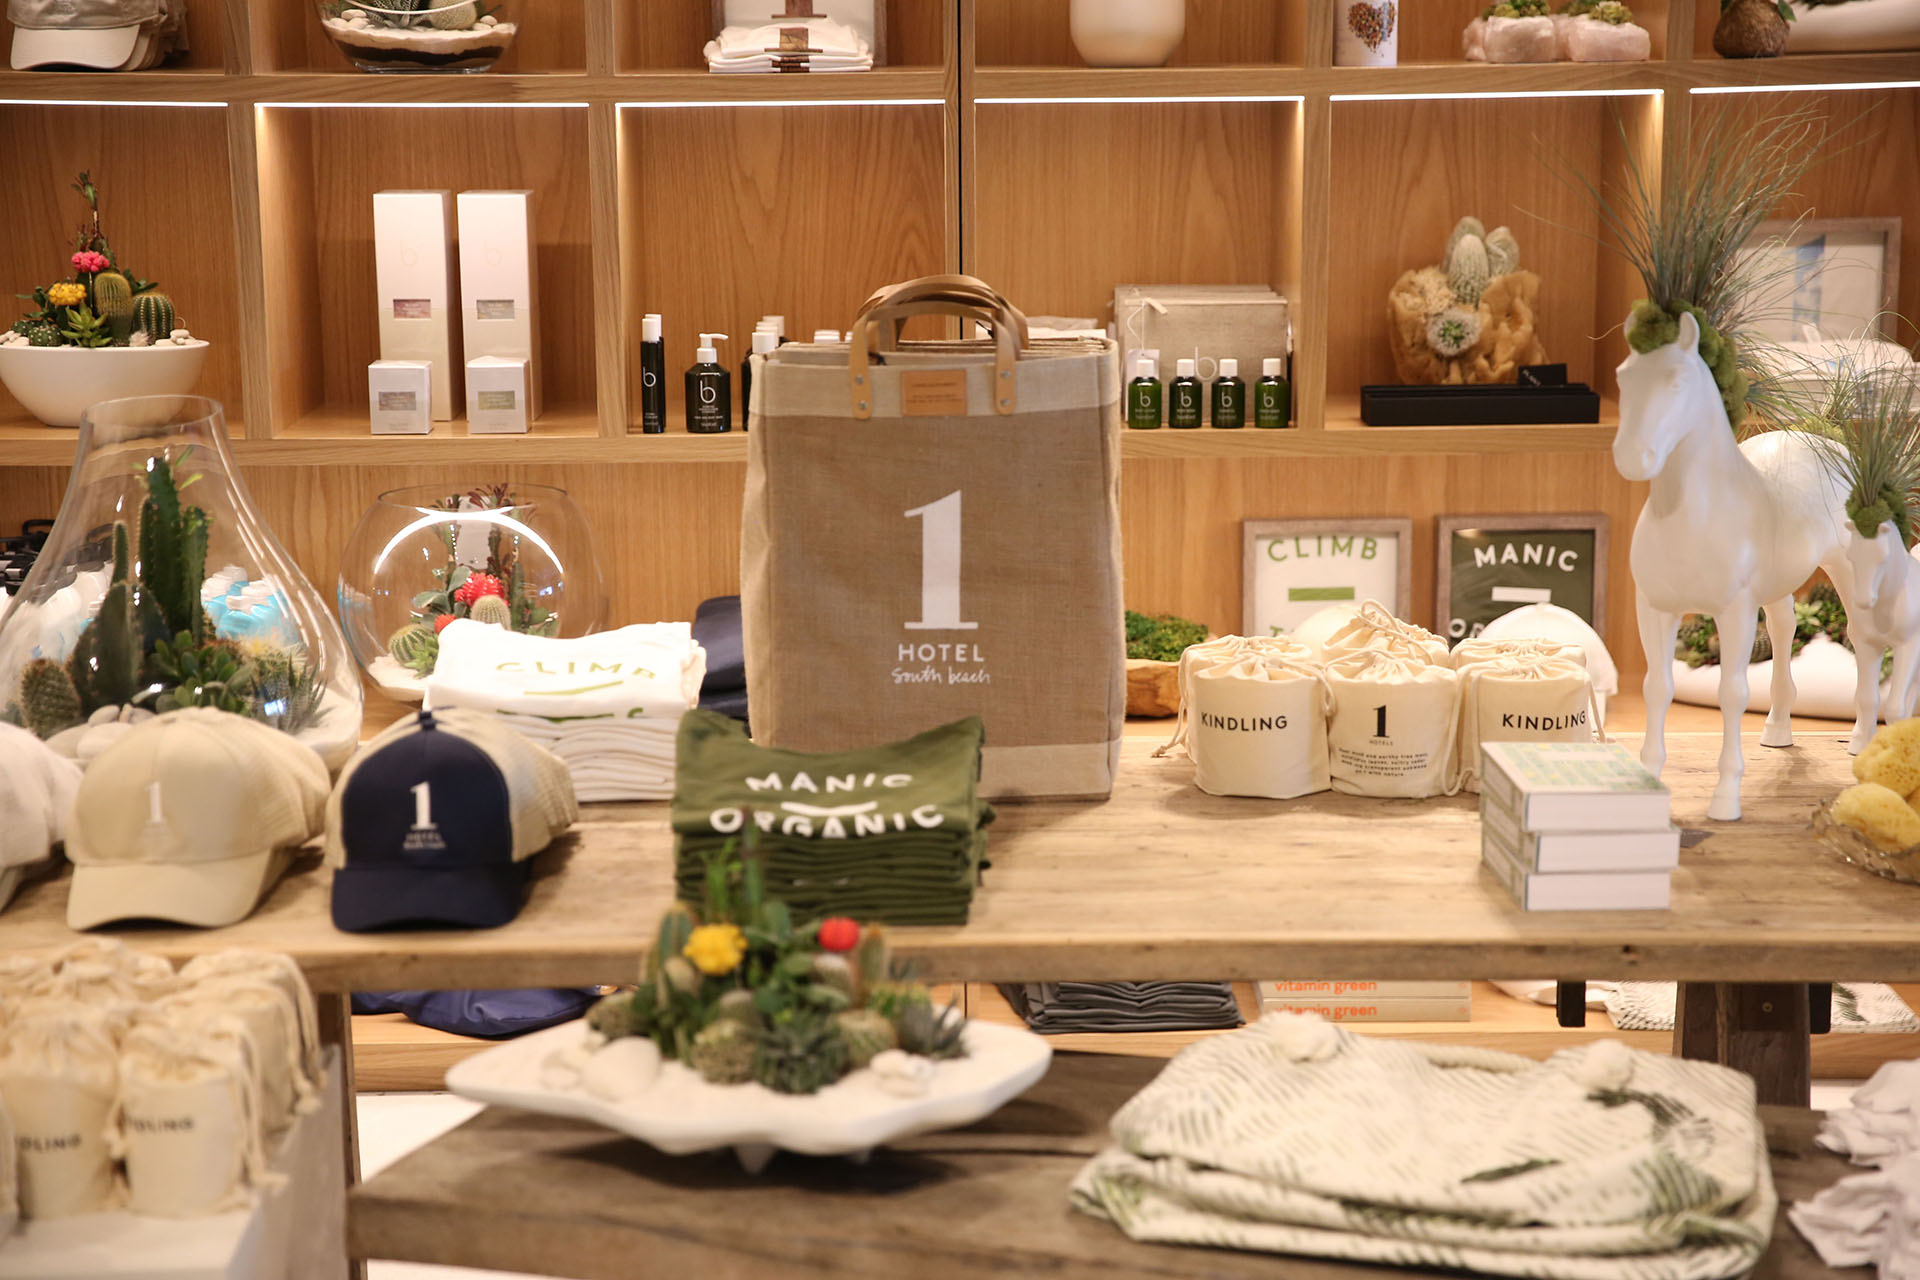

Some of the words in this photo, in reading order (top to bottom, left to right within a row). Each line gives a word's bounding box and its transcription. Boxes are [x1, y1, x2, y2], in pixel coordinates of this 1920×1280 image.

[642, 366, 657, 388] b
[699, 380, 716, 404] b
[1140, 391, 1151, 408] b
[1180, 391, 1192, 408] b
[1221, 391, 1232, 408] b
[1263, 392, 1274, 408] b
[904, 489, 979, 630] 1
[1267, 536, 1377, 562] CLIMB
[1474, 542, 1578, 572] MANIC
[898, 643, 985, 662] HOTEL
[948, 666, 991, 685] beach
[1201, 711, 1288, 731] KINDLING
[1373, 704, 1390, 738] 1
[1502, 710, 1586, 731] KINDLING
[745, 771, 913, 793] MANIC
[410, 781, 438, 831] 1
[709, 804, 944, 839] ORGANIC
[1275, 980, 1330, 992] vitamin
[1334, 981, 1378, 995] green
[1334, 1006, 1378, 1020] green
